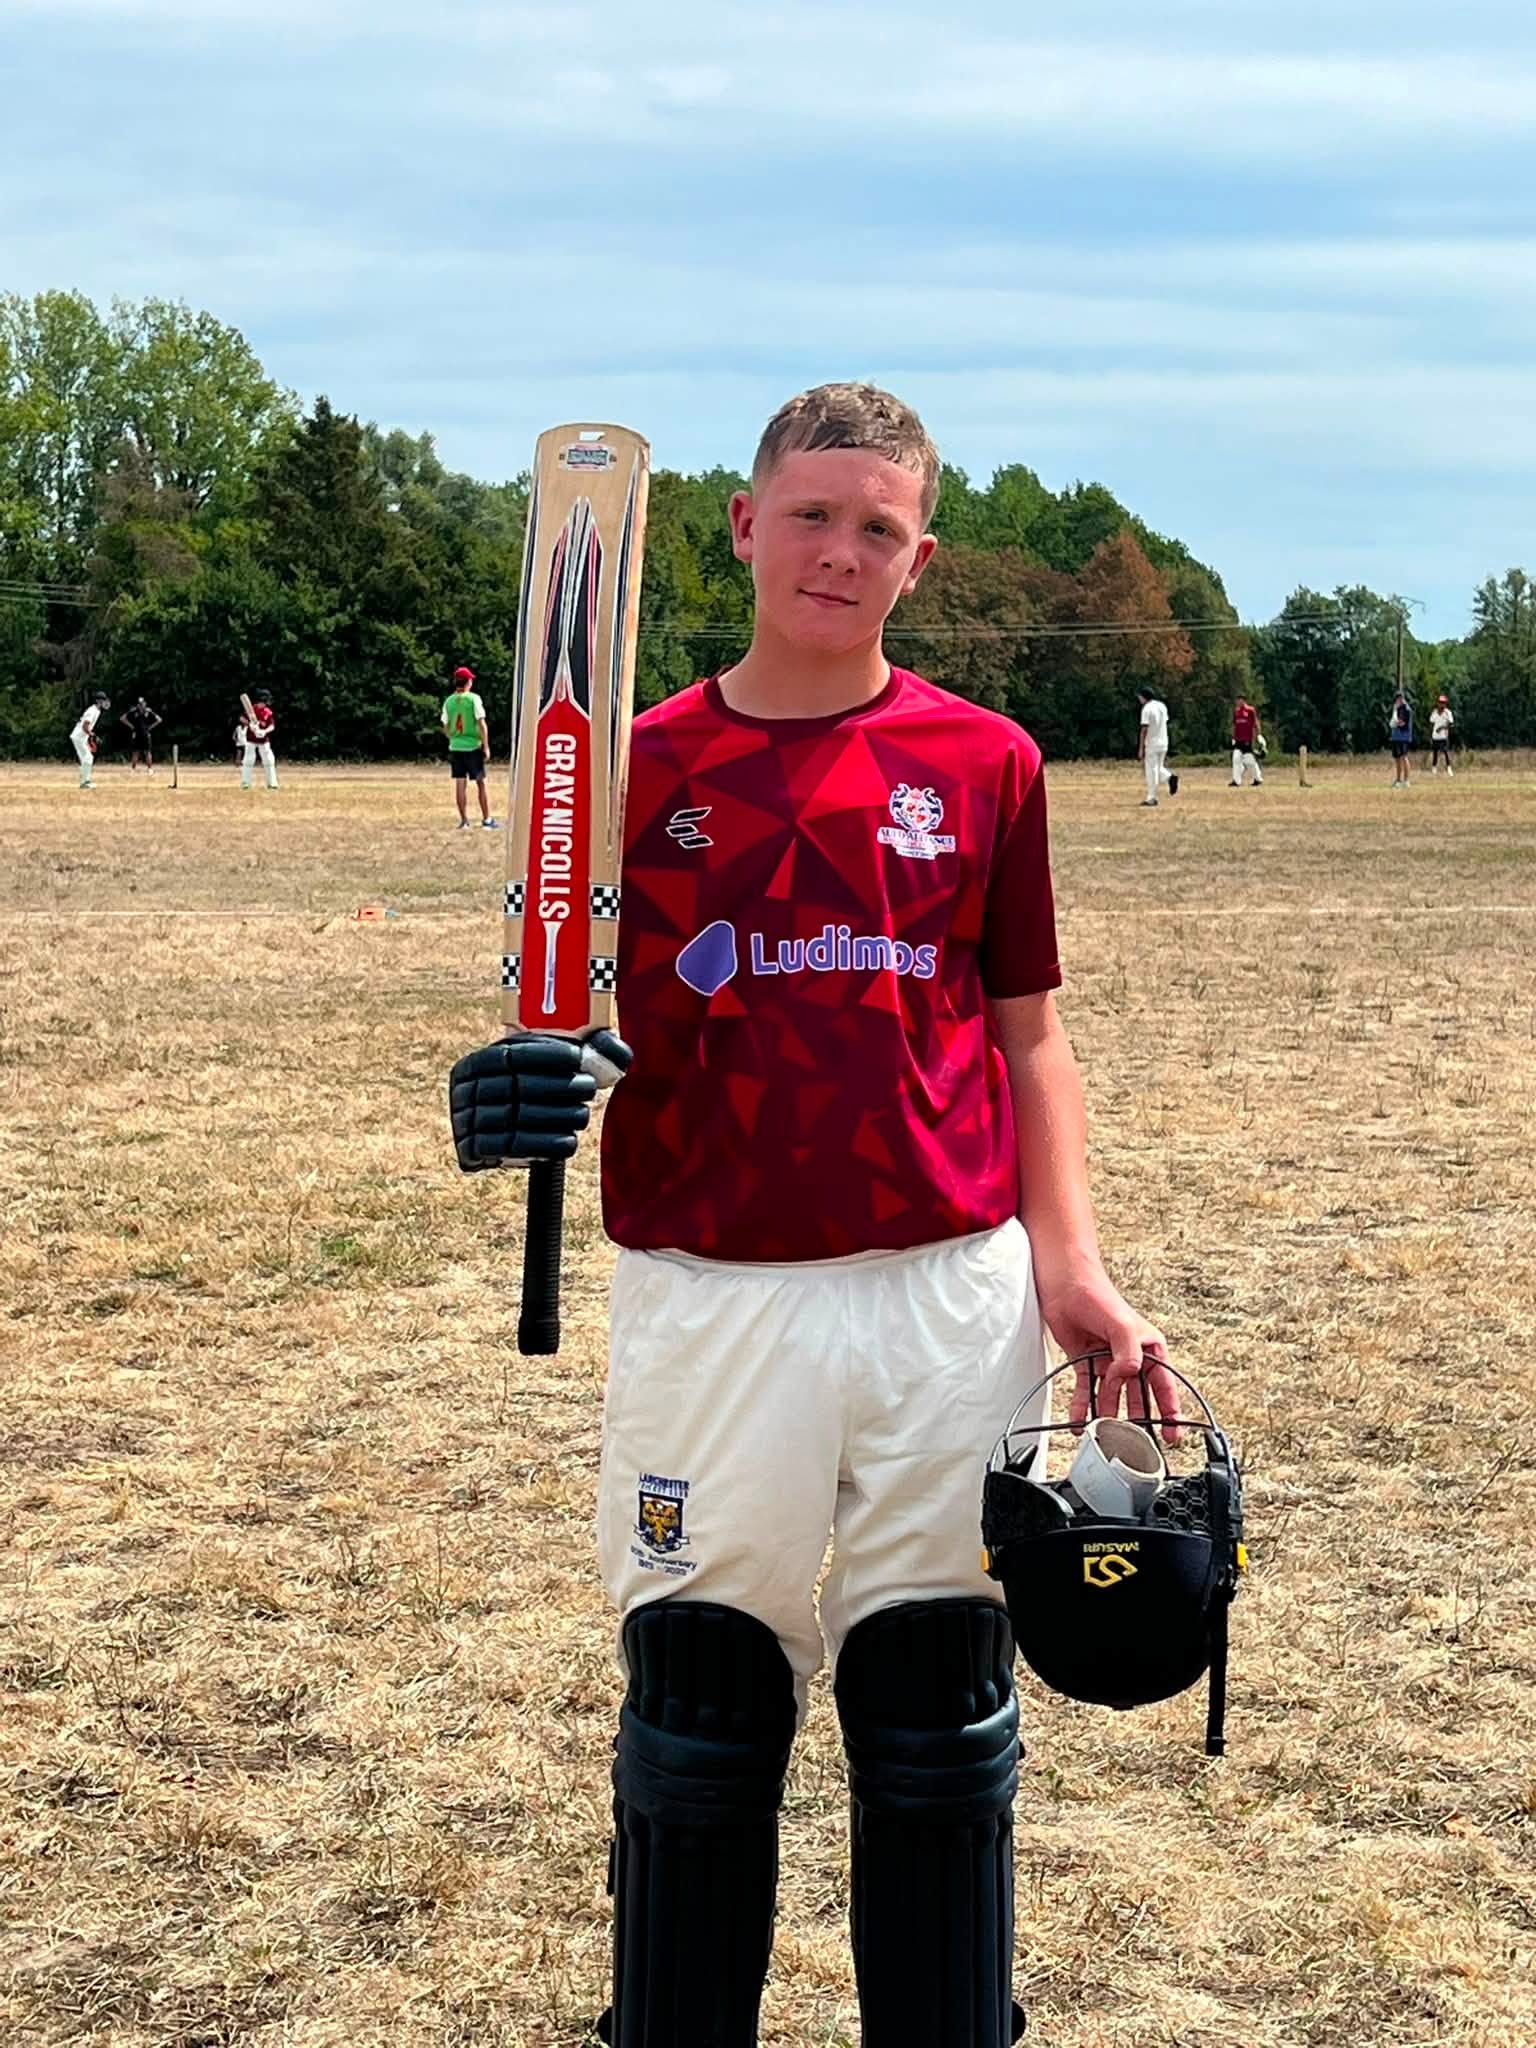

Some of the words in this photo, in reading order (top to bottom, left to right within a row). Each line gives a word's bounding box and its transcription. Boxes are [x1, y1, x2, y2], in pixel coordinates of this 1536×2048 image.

[538, 733, 577, 921] GRAY-NICOLLS
[750, 924, 938, 979] Ludimos
[1082, 1541, 1140, 1552] MASURI
